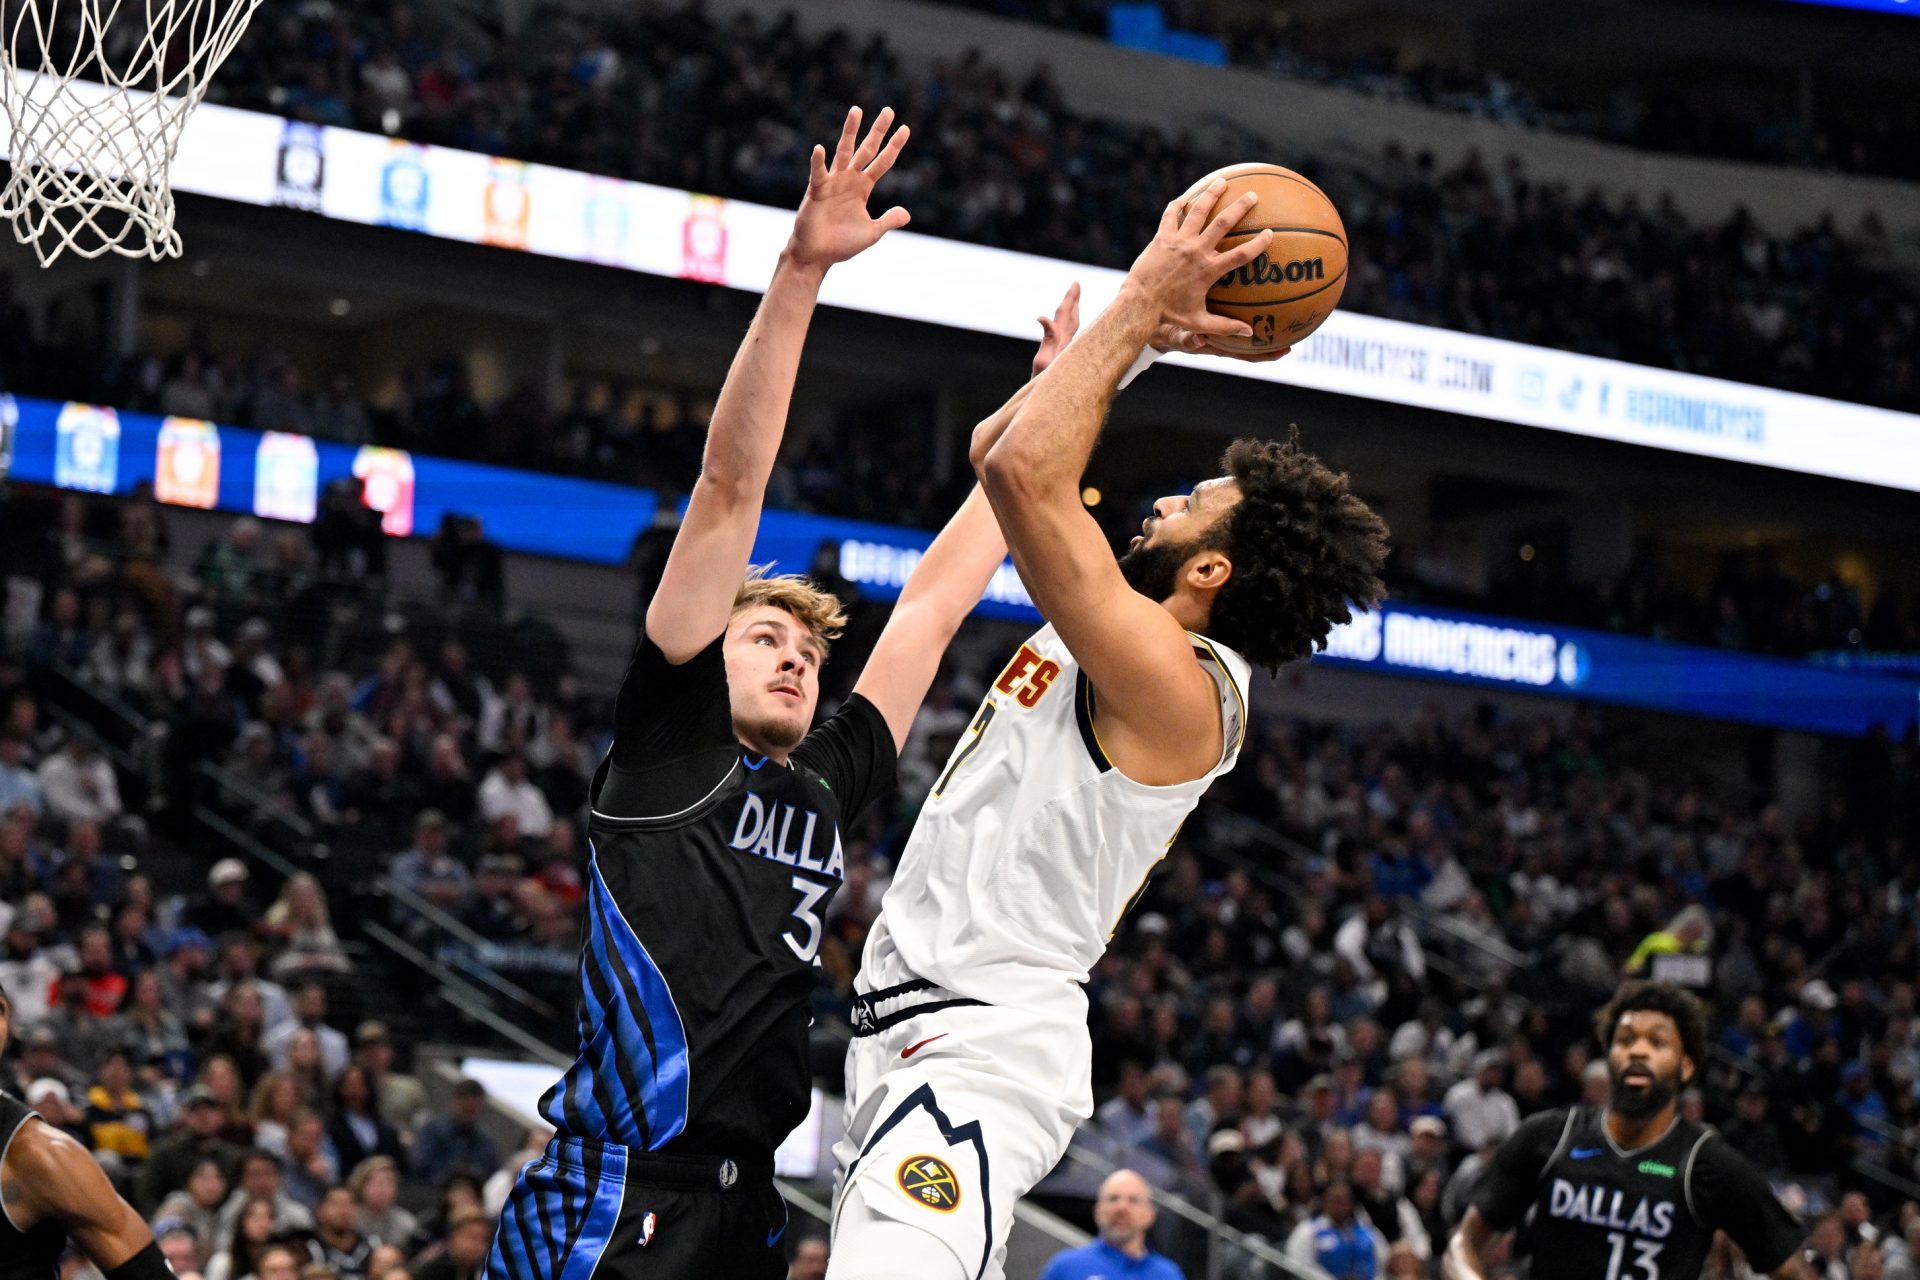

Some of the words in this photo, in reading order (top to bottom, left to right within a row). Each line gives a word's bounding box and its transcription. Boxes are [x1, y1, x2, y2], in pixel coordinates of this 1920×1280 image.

[1214, 252, 1324, 288] ilson
[729, 790, 844, 880] DALLA
[782, 874, 831, 966] 3
[1550, 1178, 1675, 1238] DALLAS
[1605, 1233, 1664, 1280] 13
